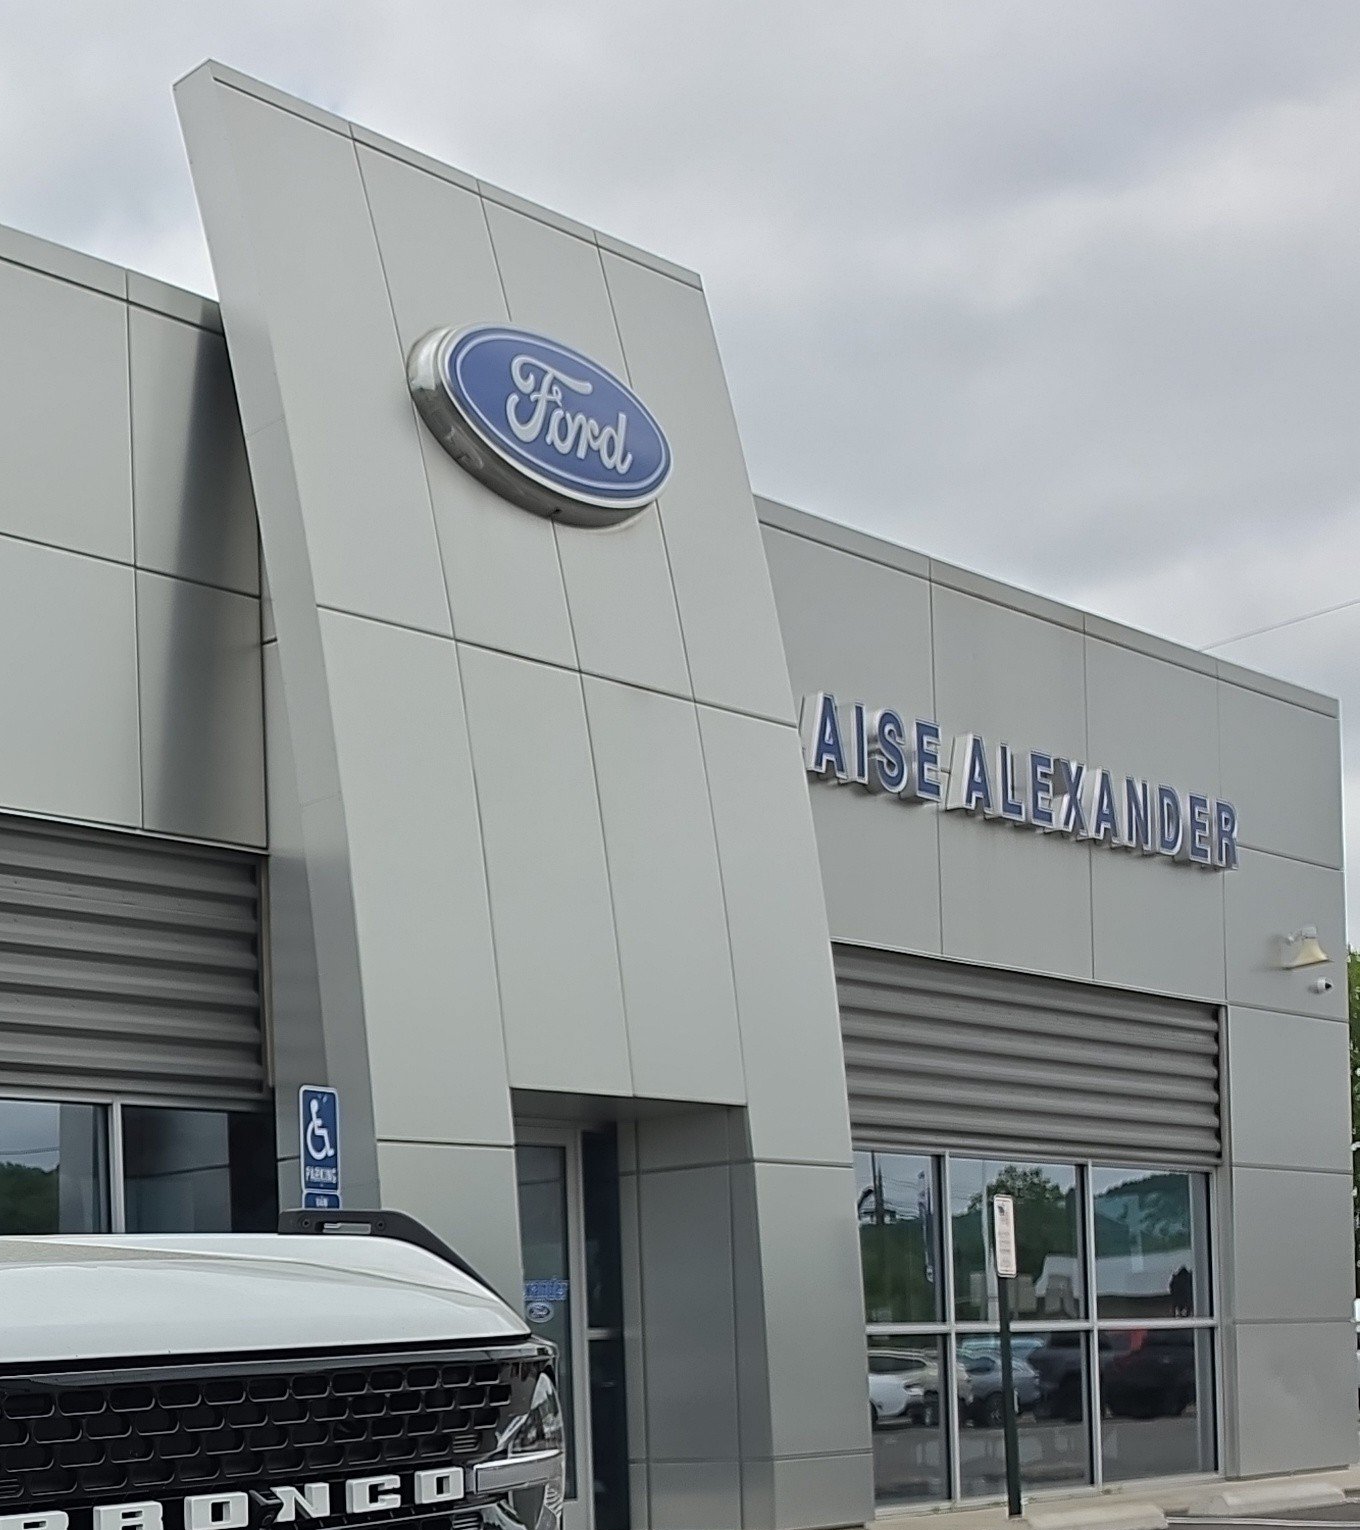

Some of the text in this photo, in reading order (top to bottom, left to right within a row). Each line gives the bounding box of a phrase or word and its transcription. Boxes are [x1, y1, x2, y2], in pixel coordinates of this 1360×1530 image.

[505, 354, 634, 475] Ford
[956, 732, 1240, 870] ALEXANDER
[305, 1165, 337, 1184] PARKING
